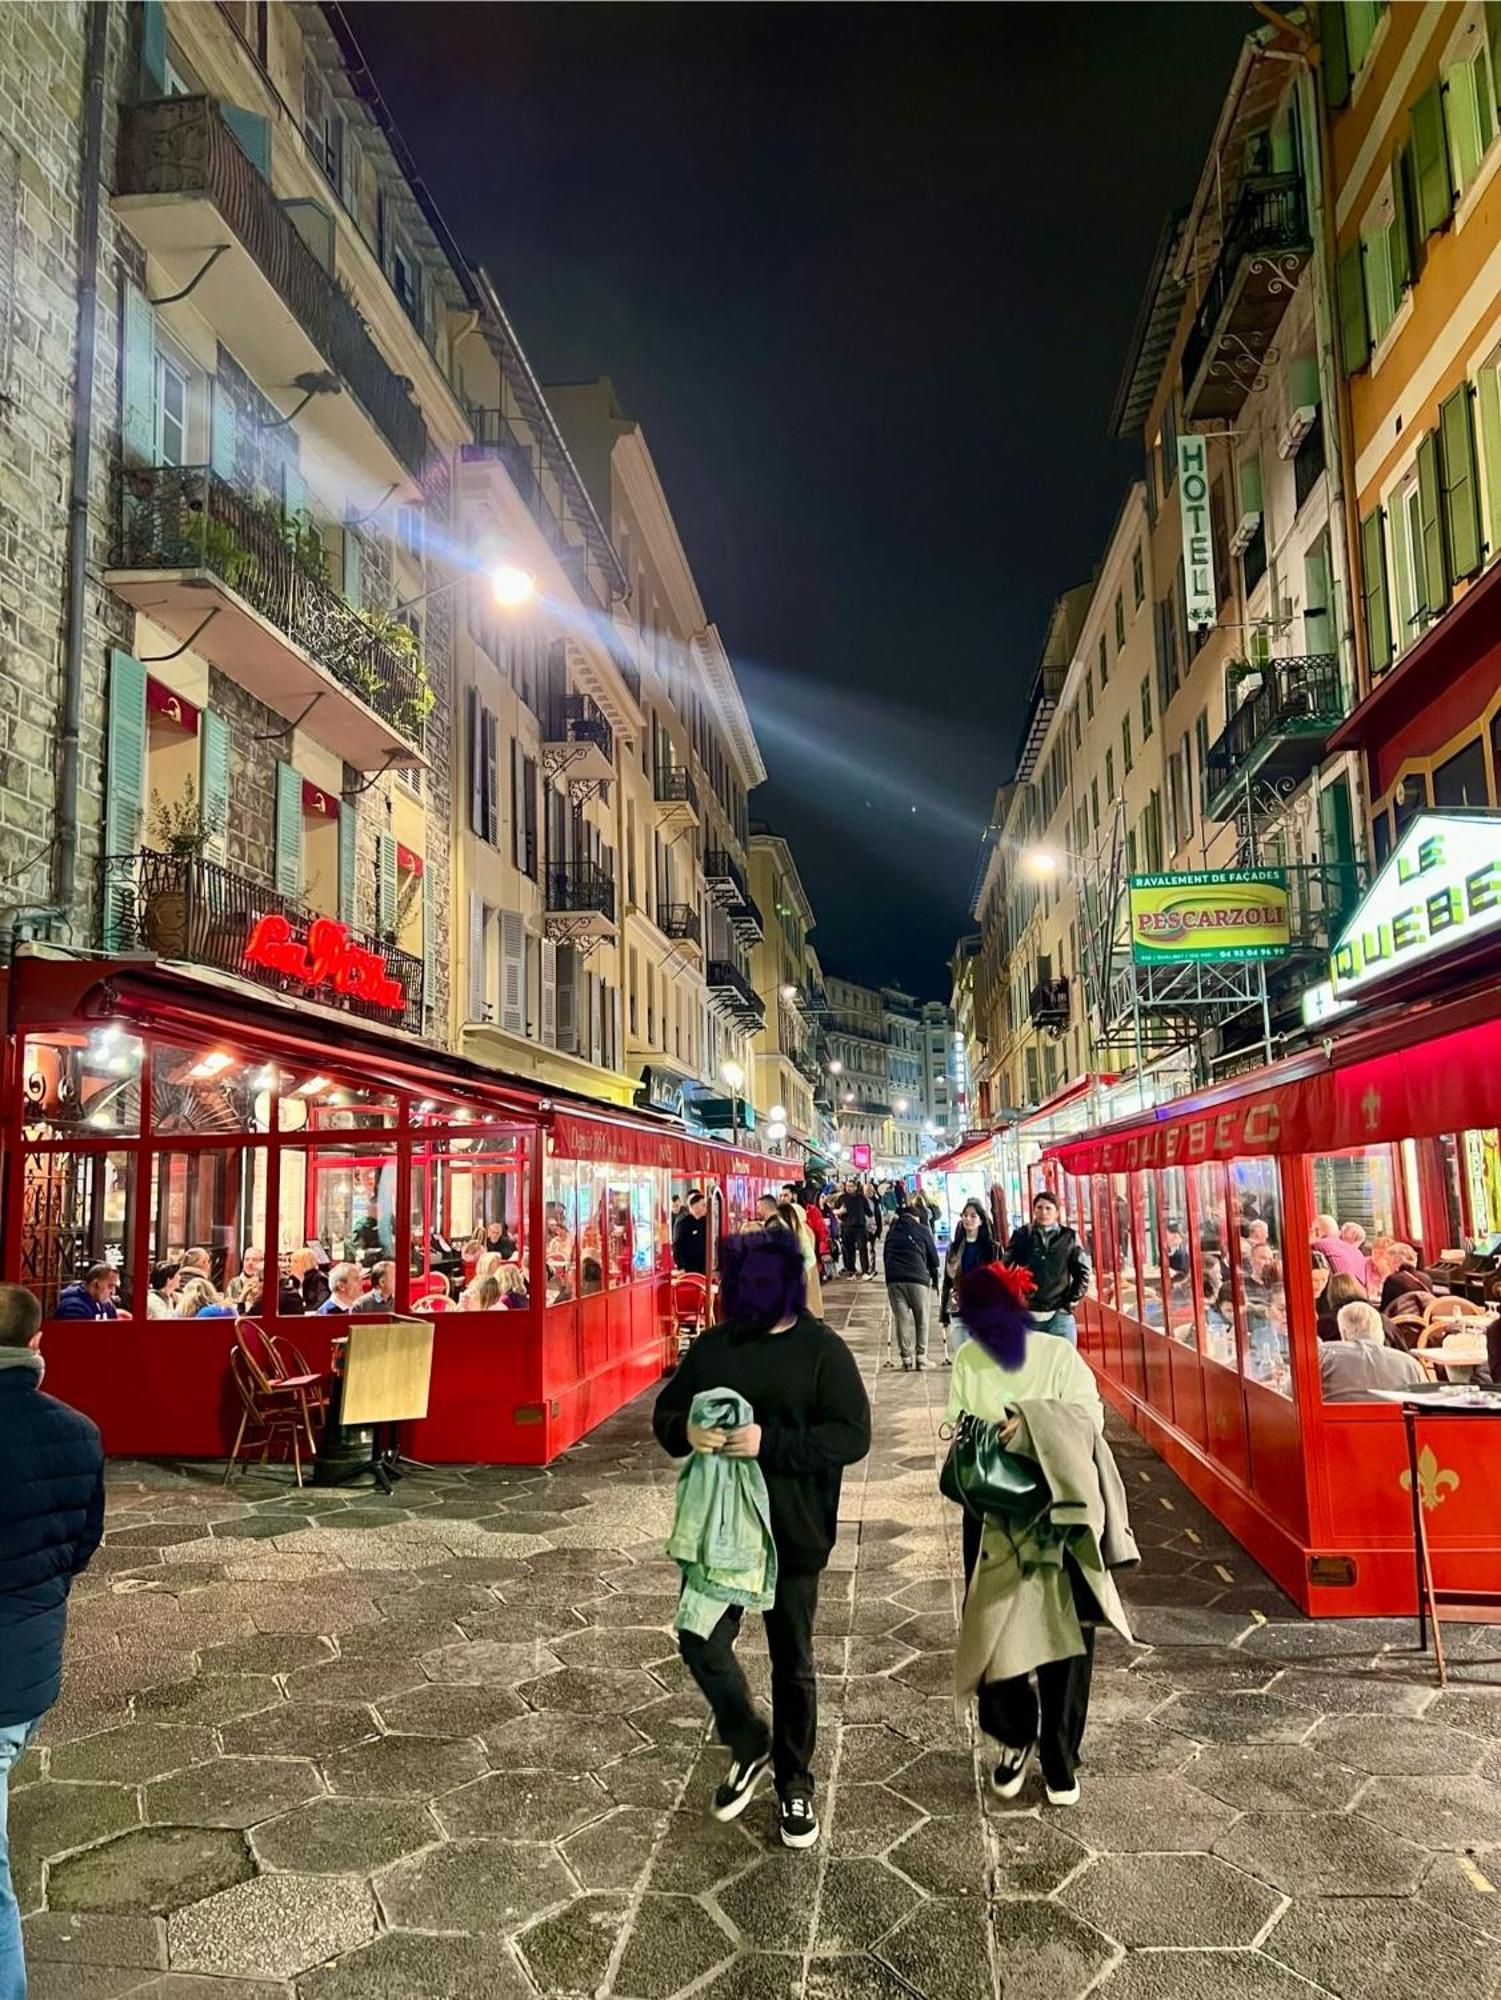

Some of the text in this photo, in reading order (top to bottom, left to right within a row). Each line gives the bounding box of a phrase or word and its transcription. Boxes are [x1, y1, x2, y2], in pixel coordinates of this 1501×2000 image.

[1182, 444, 1210, 597] HOTEL
[1136, 870, 1280, 887] RAVALEMENT DE FAÇADES
[1398, 834, 1446, 886] LE
[1137, 905, 1285, 931] PESCARZOLI
[1219, 950, 1232, 959] 04
[1246, 947, 1259, 957] 04
[1126, 1102, 1281, 1170] QUEBEC
